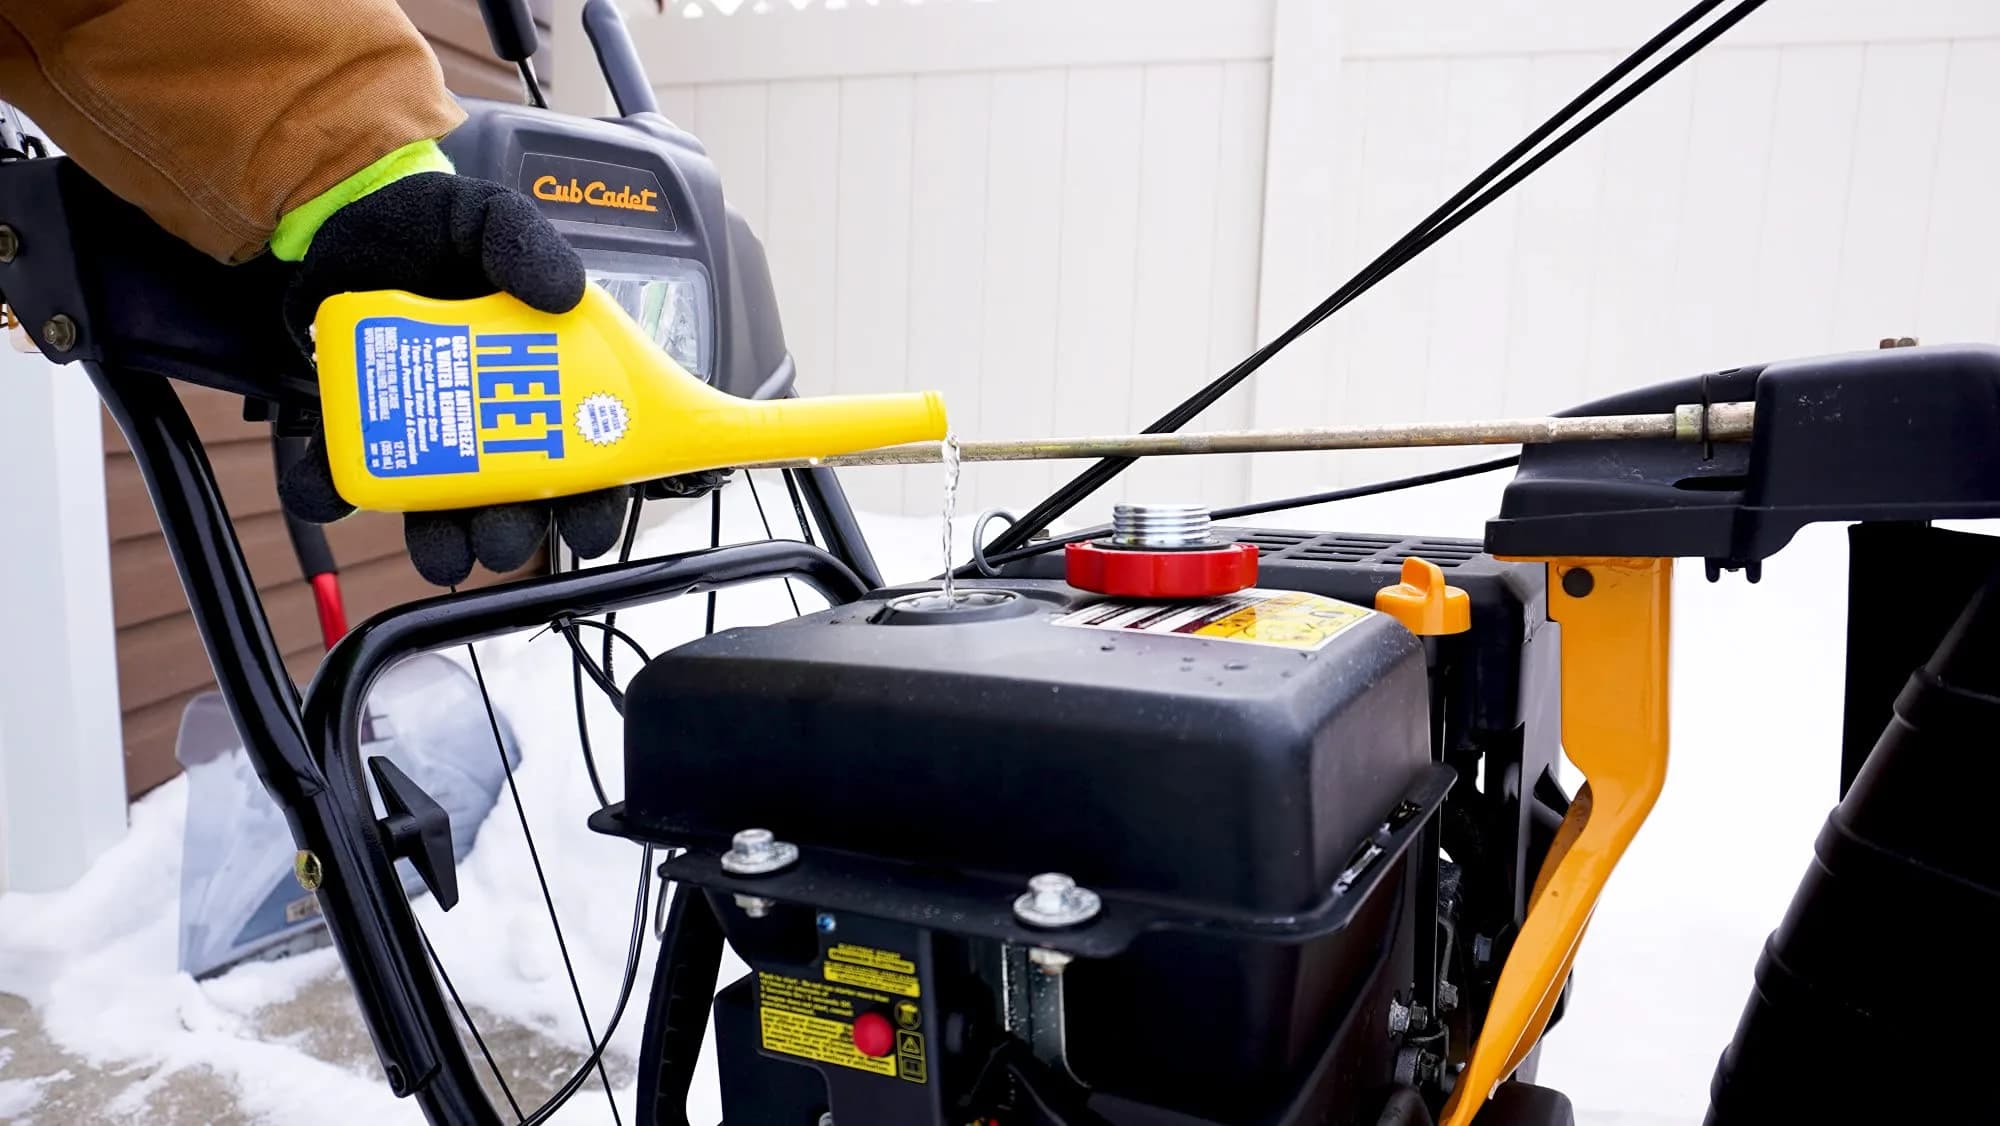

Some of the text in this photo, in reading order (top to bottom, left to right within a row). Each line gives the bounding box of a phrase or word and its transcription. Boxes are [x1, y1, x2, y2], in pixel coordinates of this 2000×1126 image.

[533, 175, 658, 212] Cub Cadet
[436, 336, 458, 447] & WATER REMOVER
[452, 335, 475, 457] GAS-LINE ANTIFREEZE
[475, 333, 565, 459] HEET
